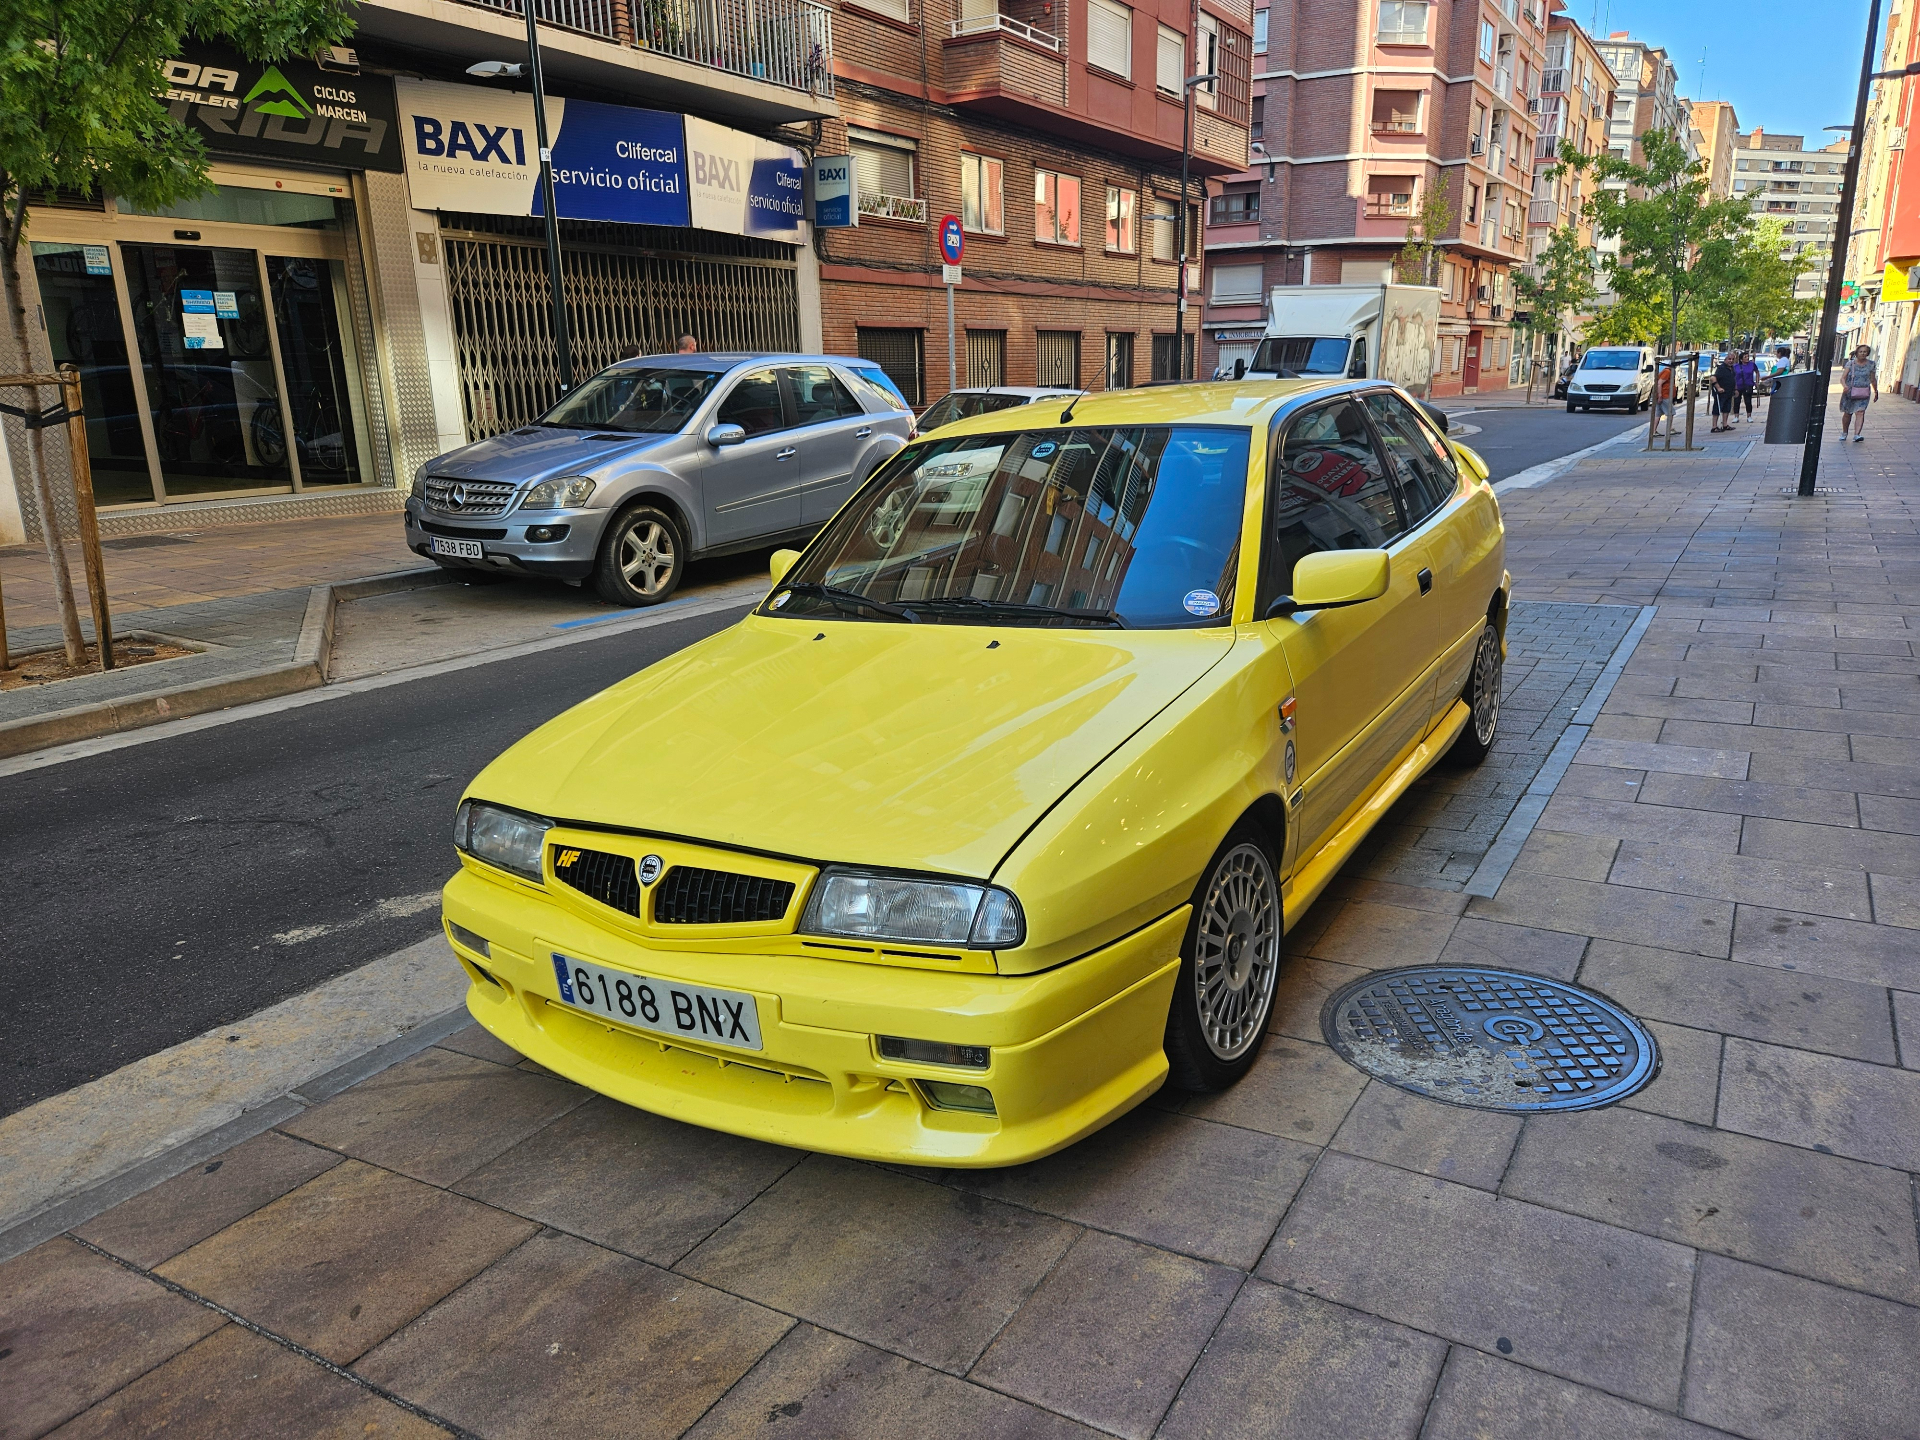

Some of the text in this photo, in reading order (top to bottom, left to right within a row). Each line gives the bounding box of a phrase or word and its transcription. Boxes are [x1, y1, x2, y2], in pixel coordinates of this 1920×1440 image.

[162, 59, 239, 92] DA
[151, 87, 239, 110] EALER
[313, 85, 357, 104] CICLOS
[316, 103, 368, 124] MARCEN
[167, 99, 388, 155] RIDA
[410, 114, 527, 166] BAXI
[615, 140, 677, 164] Clifercal
[418, 161, 529, 181] la nueva calefacción
[551, 166, 680, 194] servicio oficial
[693, 150, 742, 193] BAXI
[776, 171, 802, 190] Clifercal
[818, 167, 846, 182] BAXI
[750, 193, 804, 216] servicio oficial
[823, 205, 842, 214] servicio
[823, 213, 842, 221] oficial
[1229, 330, 1265, 339] INMOBILIAR
[435, 539, 457, 554] 7538
[458, 542, 480, 557] FBD
[556, 849, 581, 868] HF
[562, 983, 571, 995] E
[574, 967, 751, 1043] 6188 BNX
